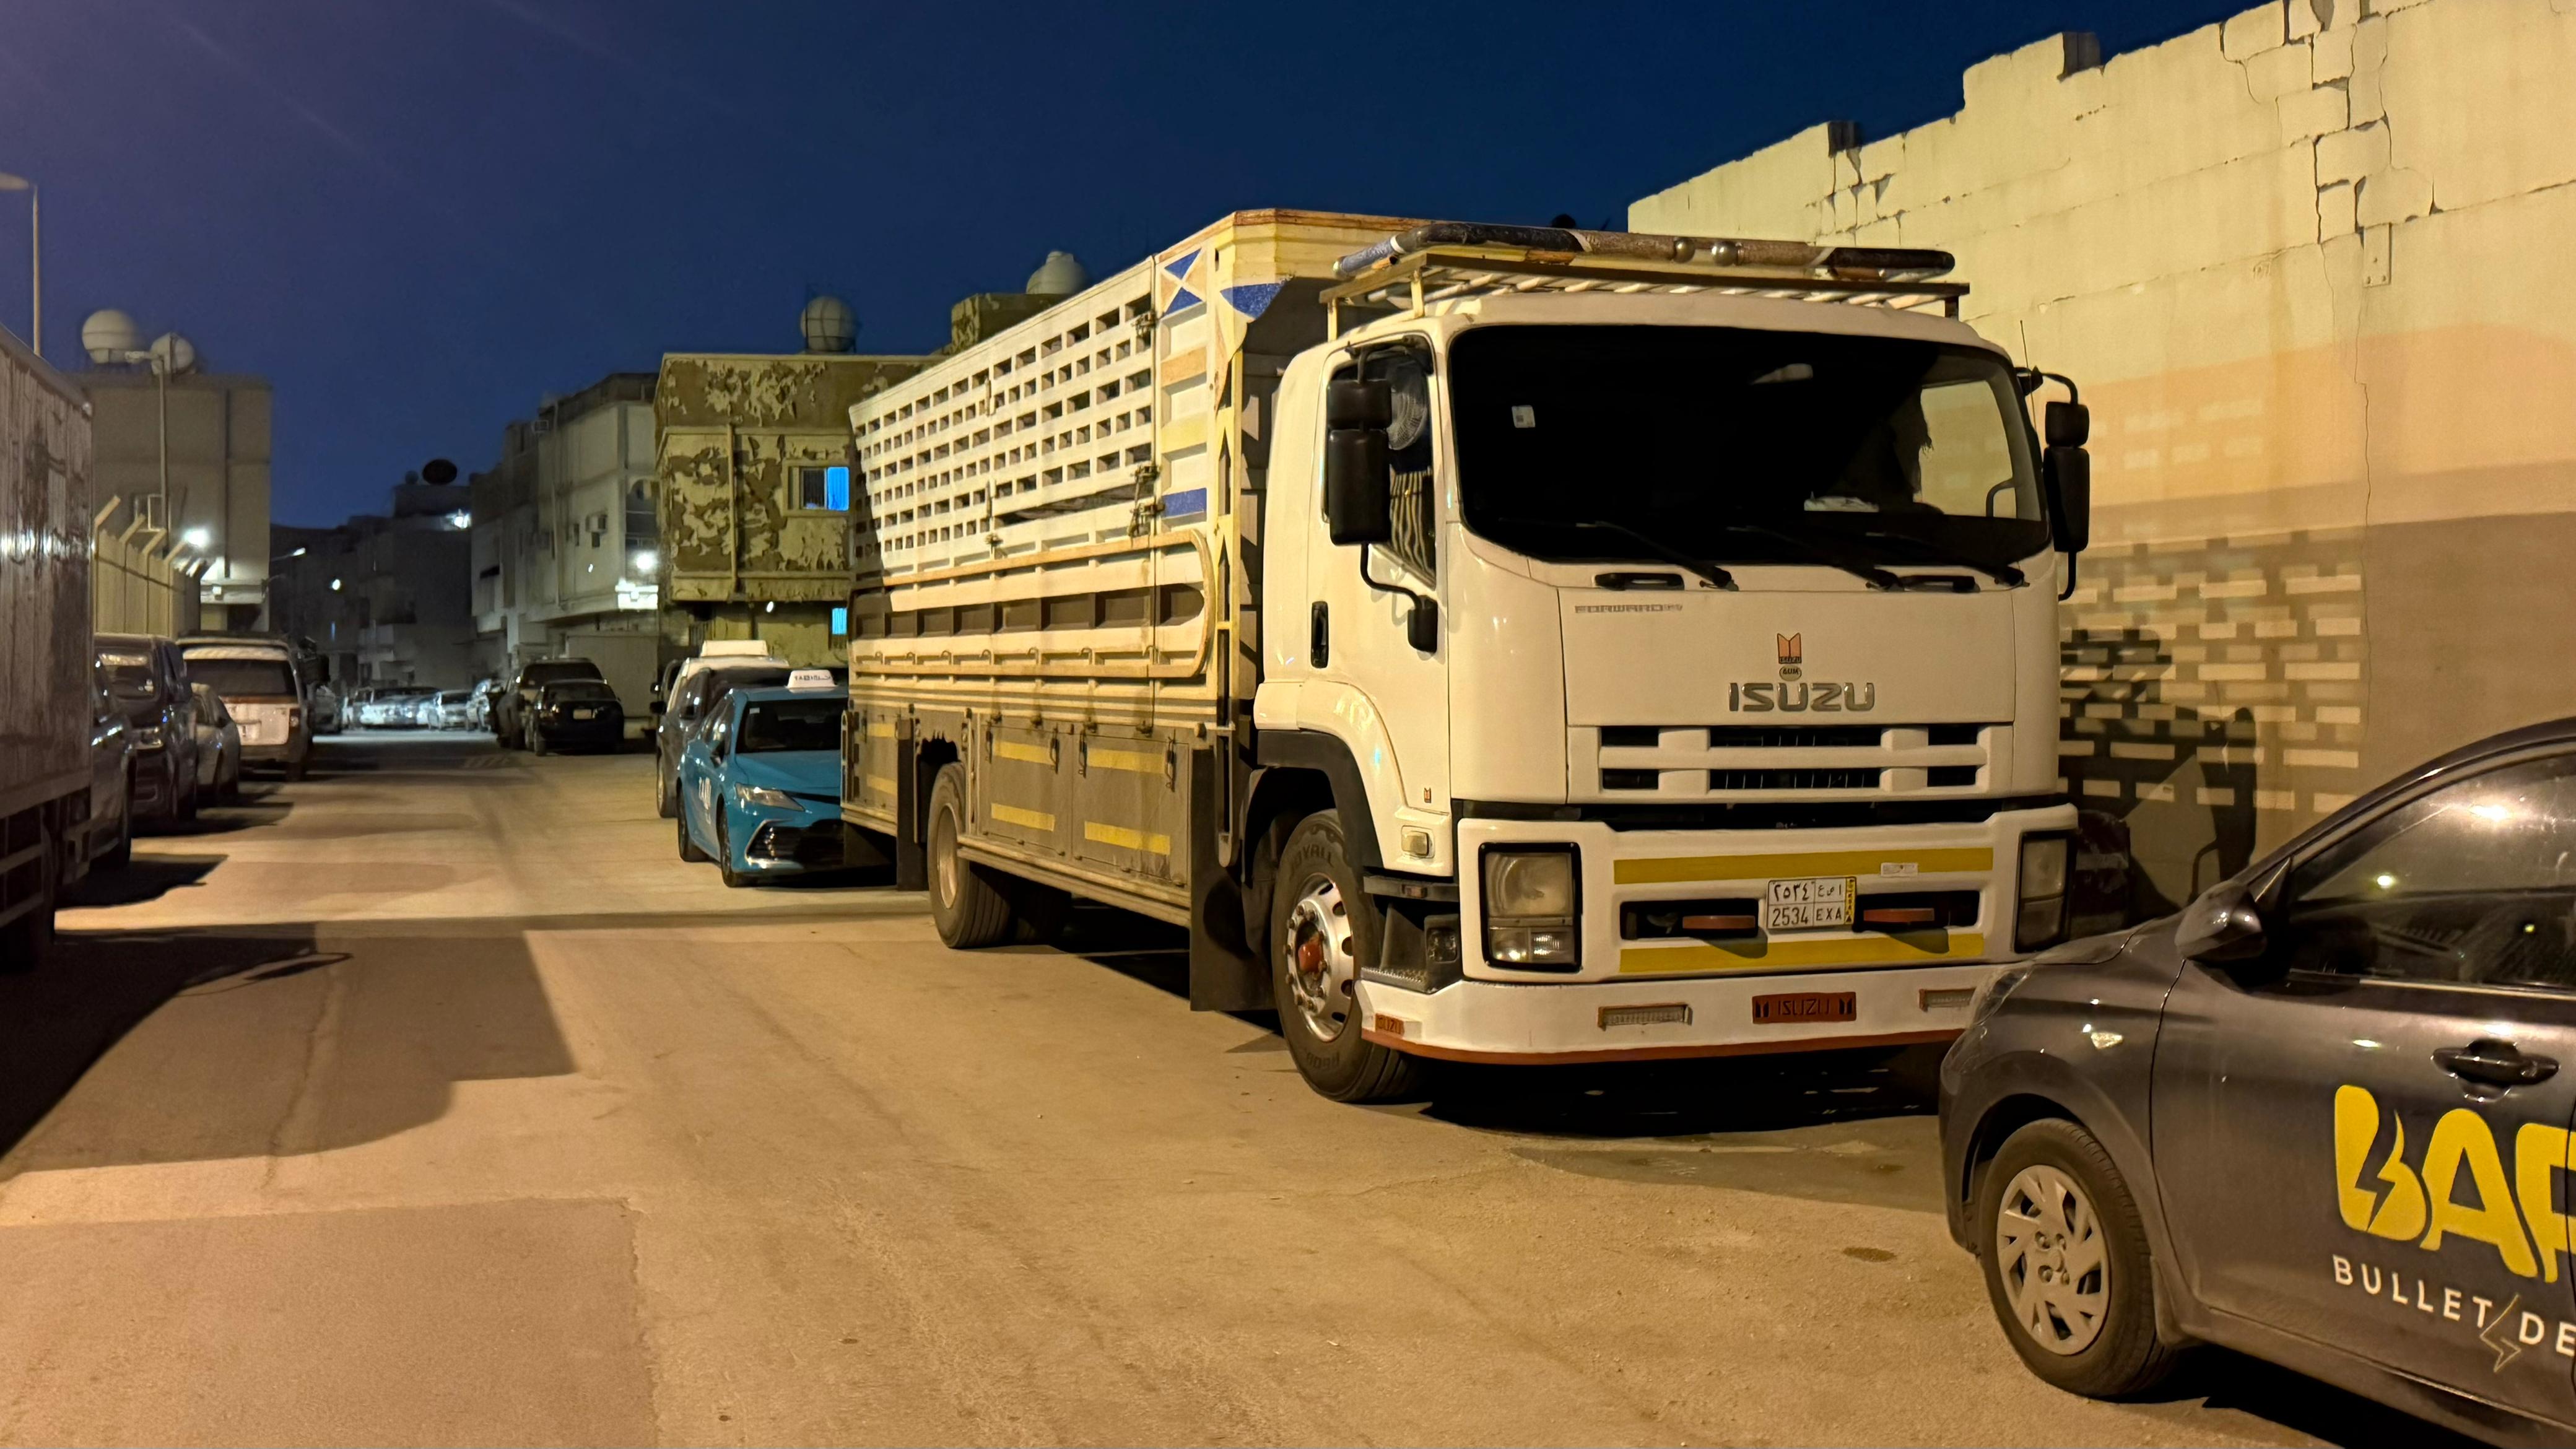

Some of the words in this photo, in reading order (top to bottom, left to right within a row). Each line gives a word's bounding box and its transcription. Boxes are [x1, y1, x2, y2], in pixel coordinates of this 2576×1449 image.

[1575, 604, 1663, 614] FORWARD
[1729, 682, 1875, 711] ISUZU
[1772, 906, 1809, 926] 2534
[1778, 998, 1830, 1016] ISUZU
[2332, 1254, 2494, 1328] BULLET
